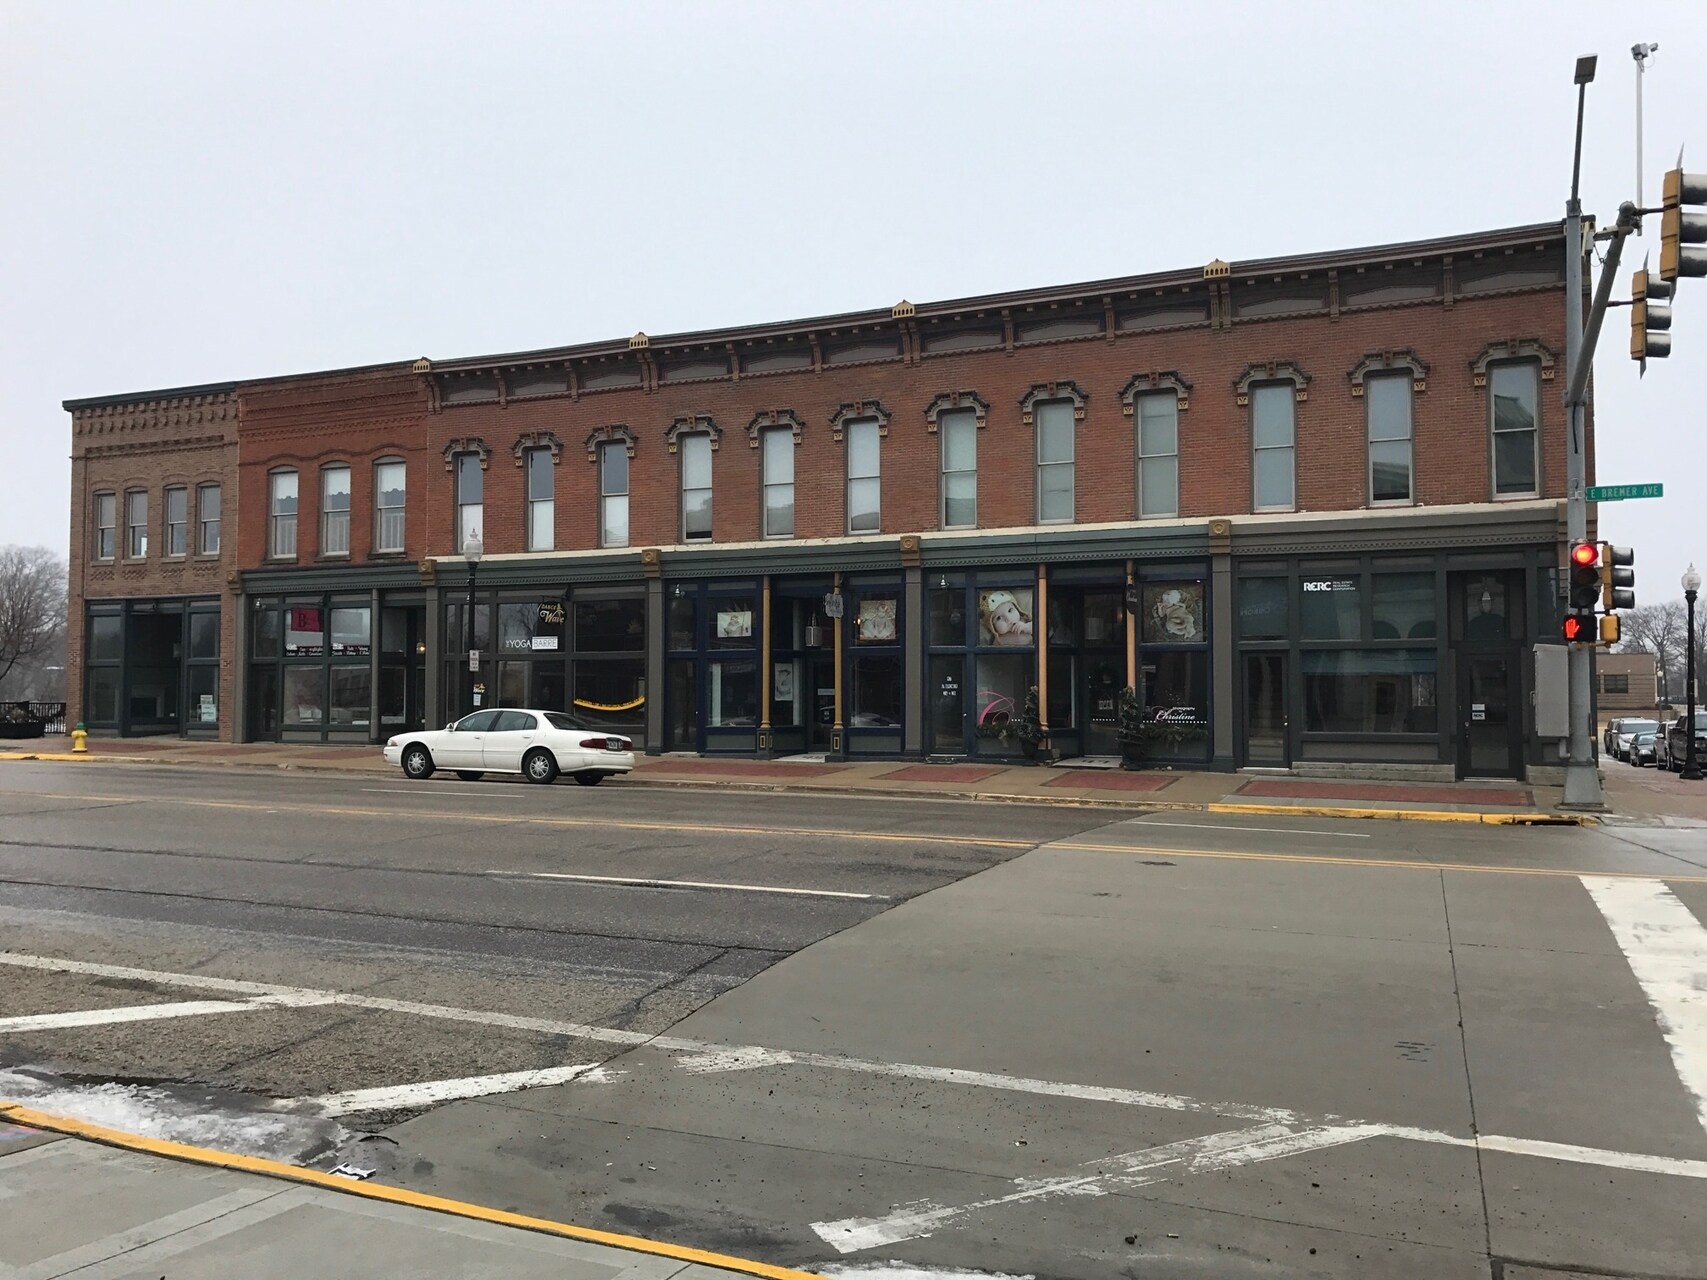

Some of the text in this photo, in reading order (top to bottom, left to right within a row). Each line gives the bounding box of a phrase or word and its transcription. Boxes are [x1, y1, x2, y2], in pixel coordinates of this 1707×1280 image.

[1590, 485, 1658, 498] E BREMER AVE
[1303, 581, 1331, 591] RERC
[510, 639, 532, 649] YOGA
[533, 639, 557, 648] BARRE
[1155, 708, 1196, 721] Christine
